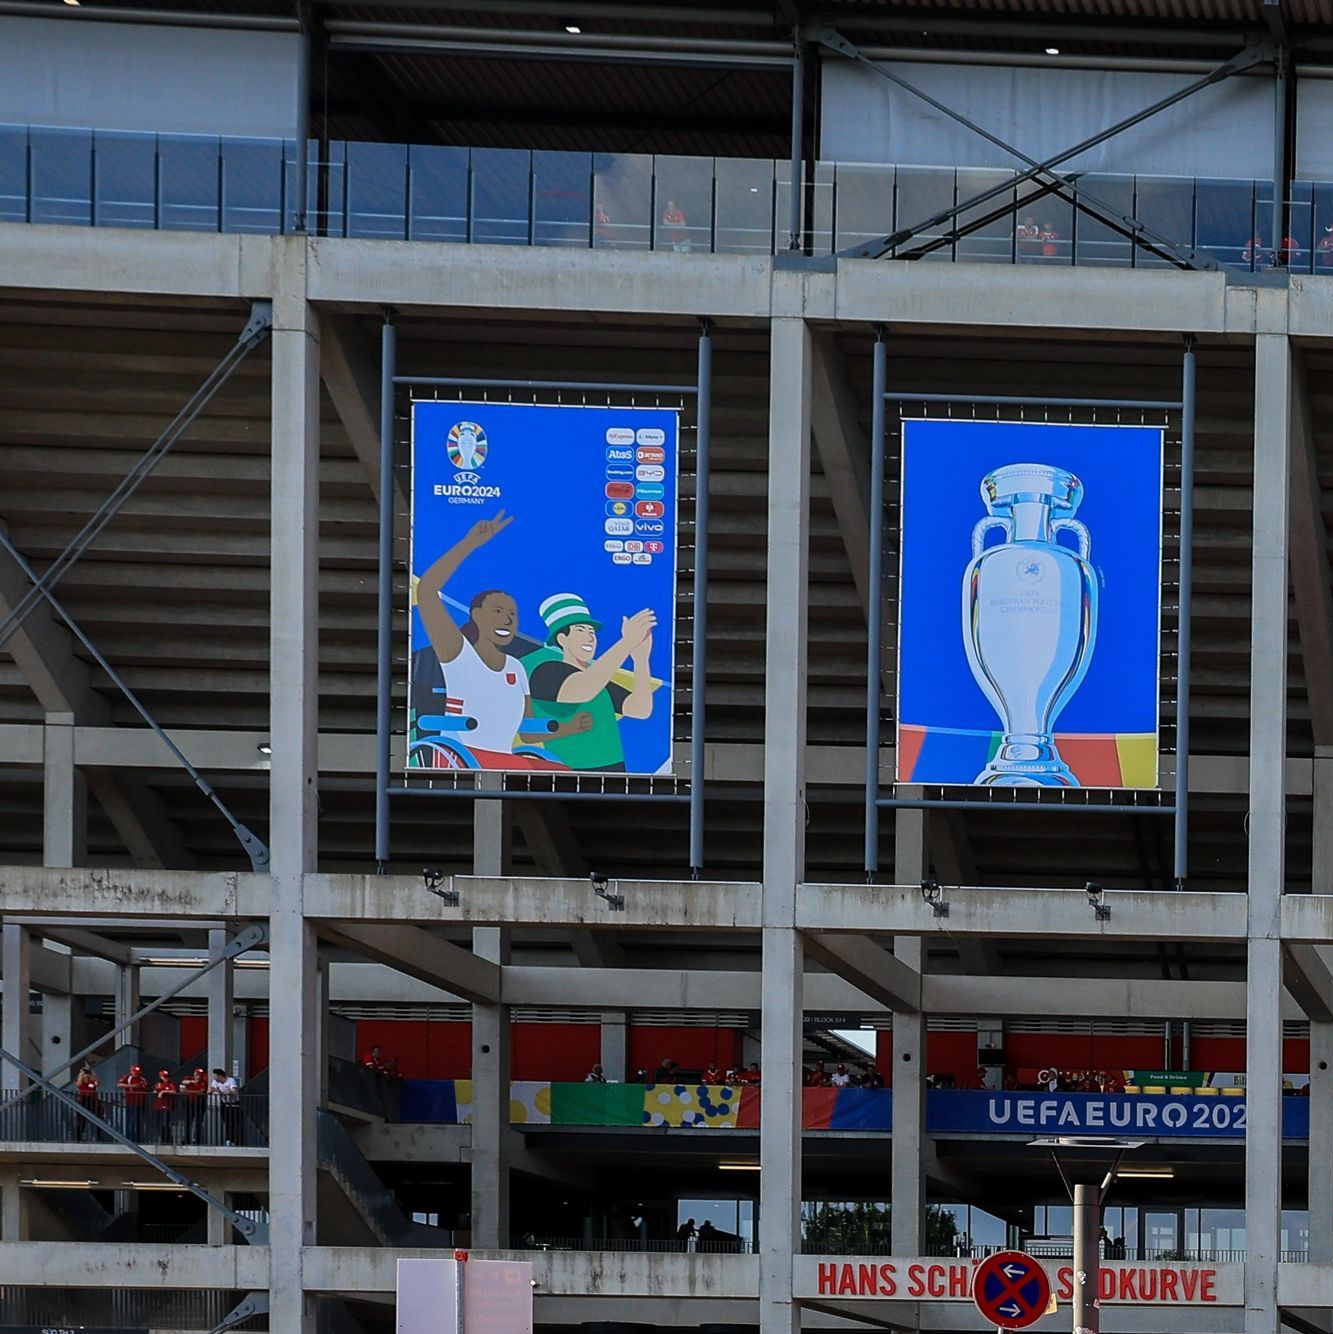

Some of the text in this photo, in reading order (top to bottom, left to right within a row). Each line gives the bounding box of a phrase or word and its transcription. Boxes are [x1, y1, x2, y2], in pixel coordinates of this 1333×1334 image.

[454, 473, 480, 484] UEFA
[433, 485, 501, 497] EURO2024
[636, 523, 663, 531] vivo
[818, 1263, 896, 1295] HANS
[1057, 1265, 1217, 1301] SDKURVE
